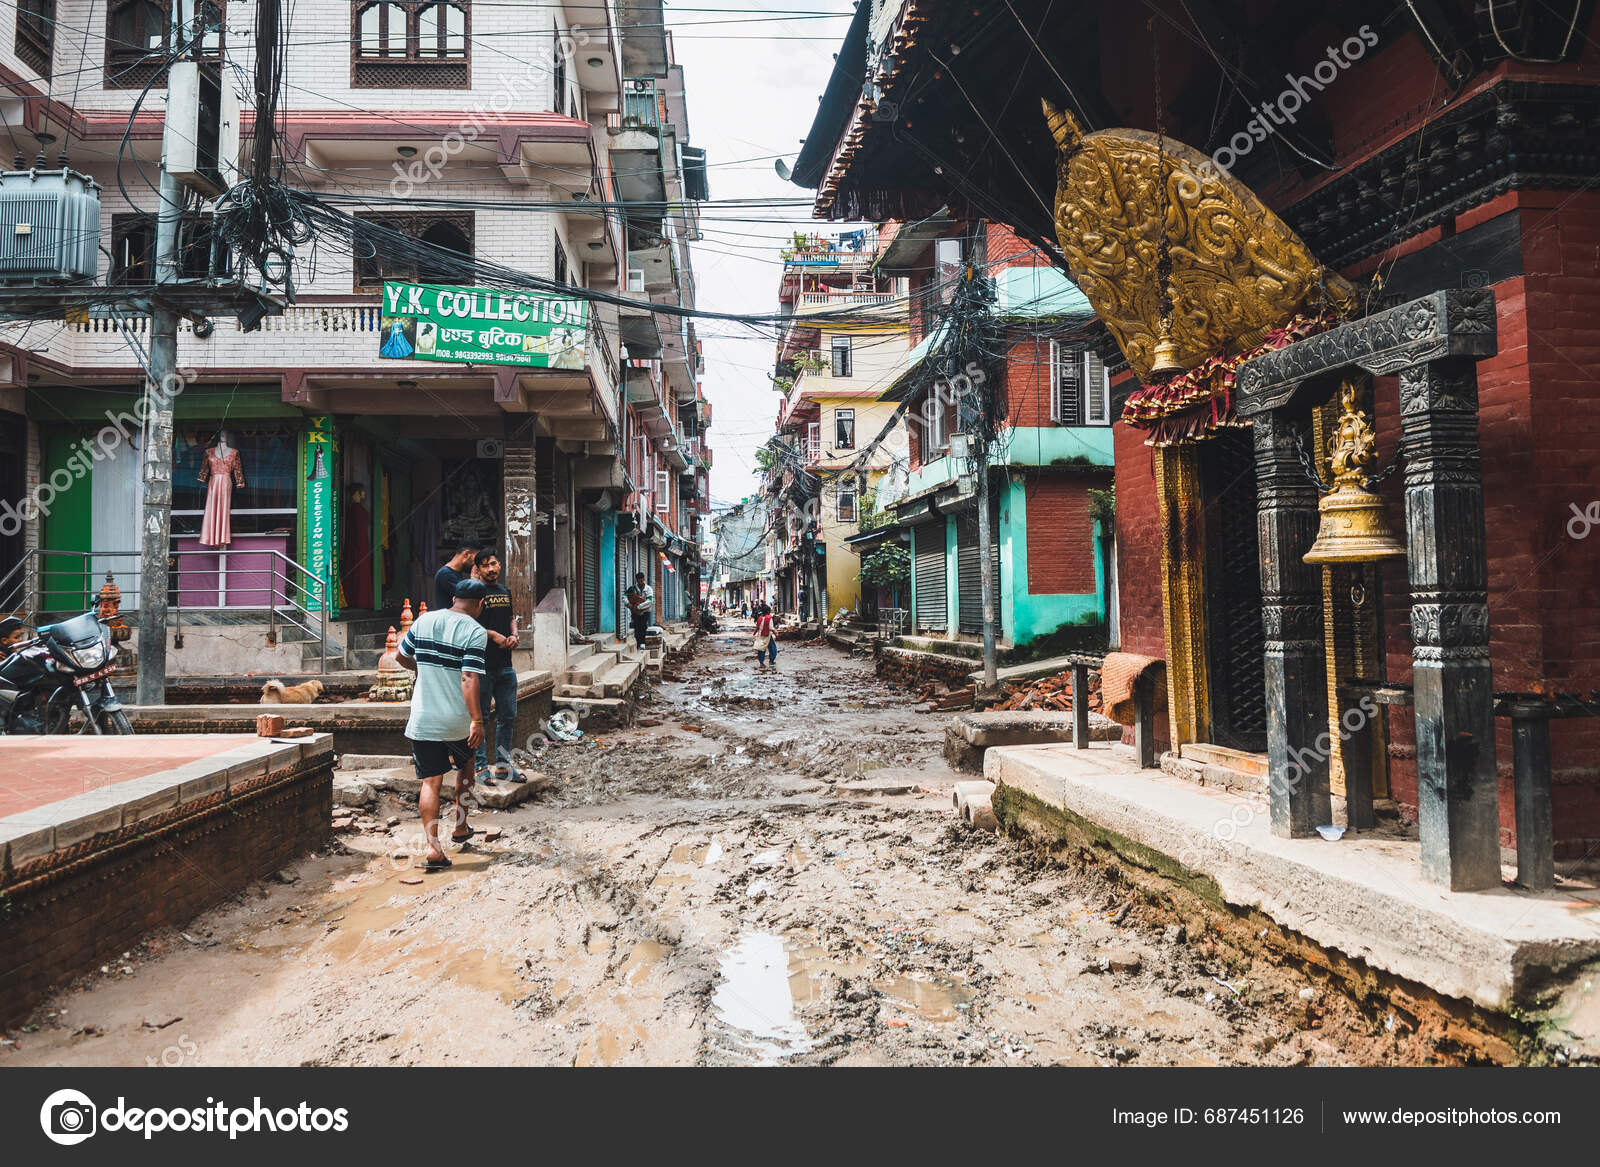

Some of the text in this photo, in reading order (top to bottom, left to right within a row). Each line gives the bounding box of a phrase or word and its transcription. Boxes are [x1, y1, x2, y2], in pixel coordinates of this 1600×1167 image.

[386, 286, 583, 325] Y.K. COLLECTION
[440, 326, 524, 349] एण्ड बुटिक
[312, 481, 324, 539] COLLECTION
